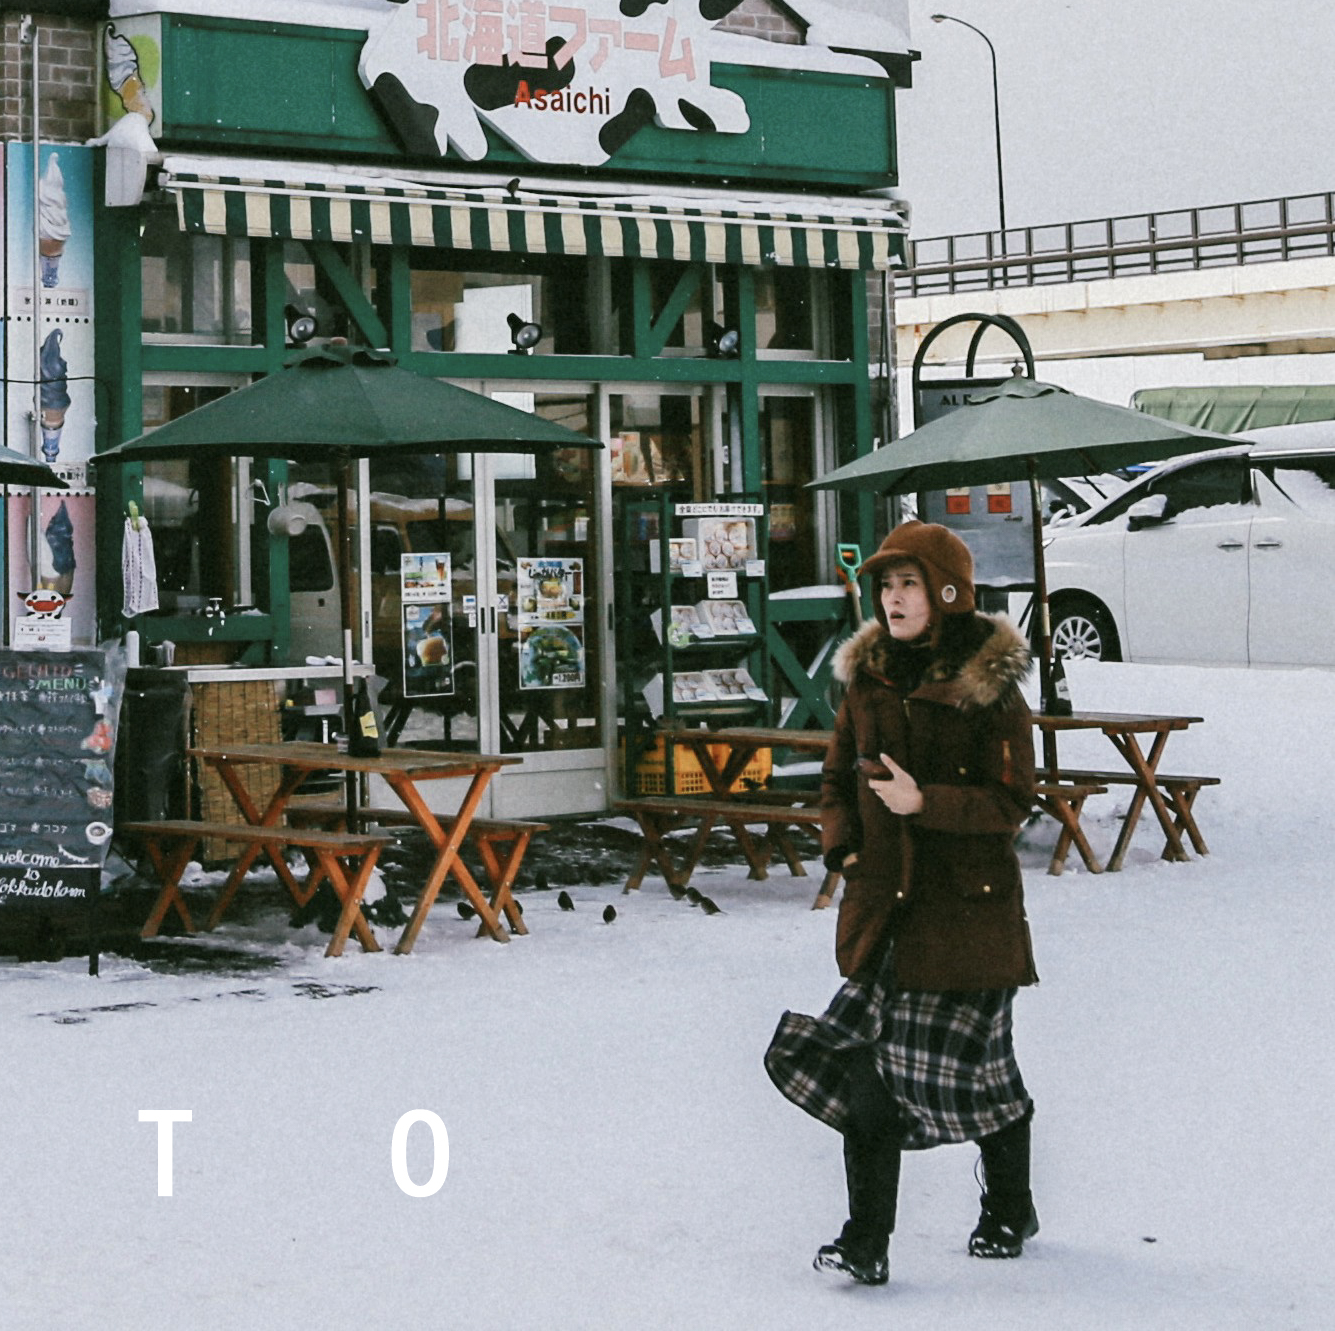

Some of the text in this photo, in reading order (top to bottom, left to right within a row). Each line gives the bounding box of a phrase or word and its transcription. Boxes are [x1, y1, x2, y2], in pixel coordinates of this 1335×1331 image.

[513, 78, 612, 117] Asaichi
[36, 678, 88, 691] MENU
[23, 866, 41, 881] to
